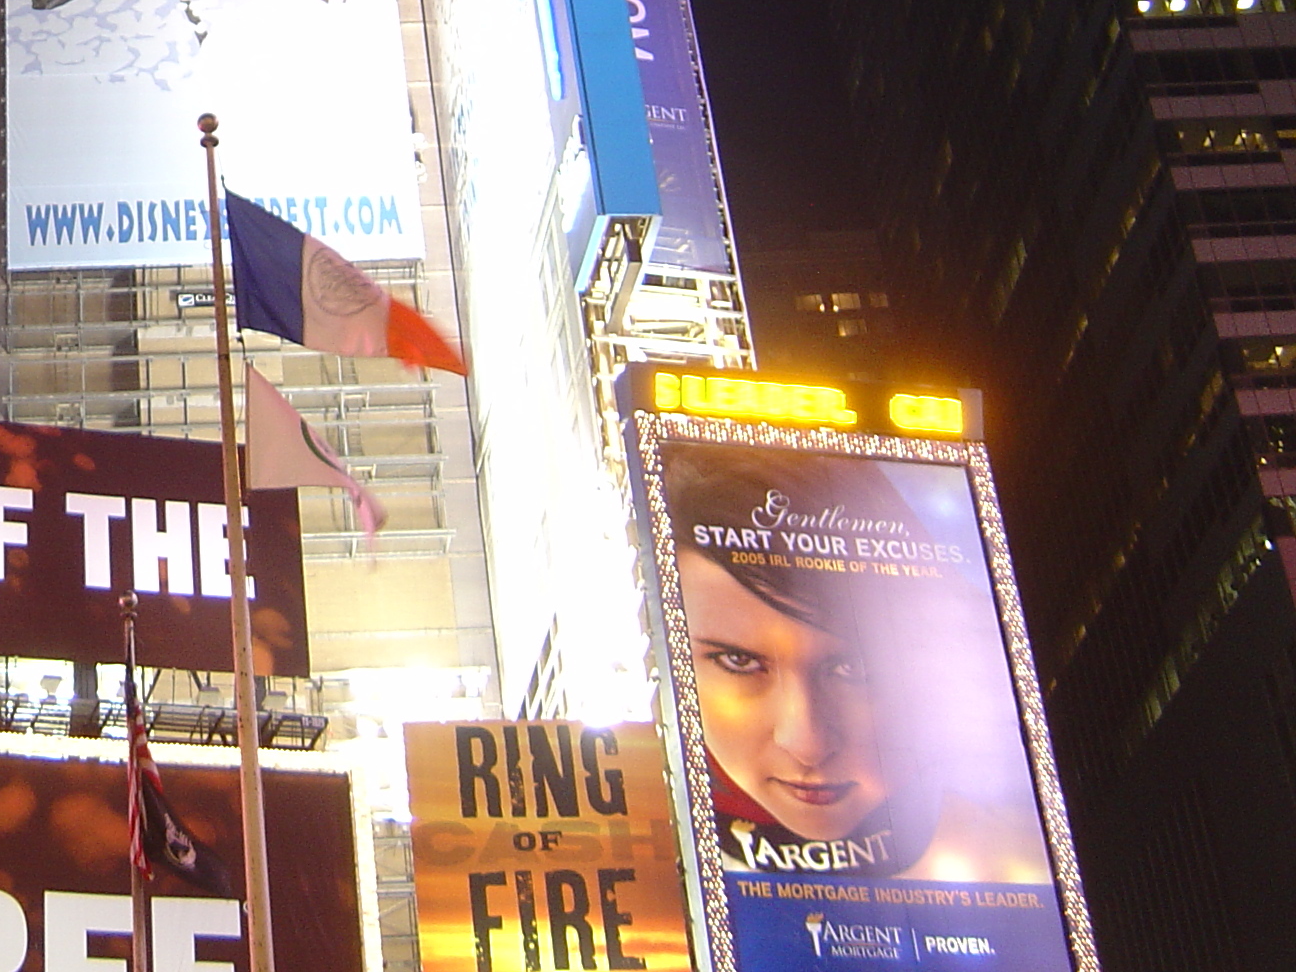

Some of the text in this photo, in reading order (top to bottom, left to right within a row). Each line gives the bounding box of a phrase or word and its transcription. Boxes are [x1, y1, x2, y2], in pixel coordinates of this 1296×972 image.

[751, 489, 911, 538] Gentlemen,
[64, 492, 257, 599] THE
[693, 524, 972, 565] START YOUR EXCUSES.
[731, 551, 943, 579] 2005 IRL ROOKIE OF THE YEAR.
[455, 725, 629, 819] RING
[411, 819, 678, 867] CASH
[512, 830, 563, 851] OF
[755, 830, 892, 871] ARGENT
[737, 880, 1044, 909] THE MORTGAGE INDUSTRY'S LEADER.
[468, 868, 648, 972] FIRE
[823, 920, 902, 945] ARGENT
[831, 944, 900, 959] MORTGAGE
[925, 936, 995, 956] PROVEN.
